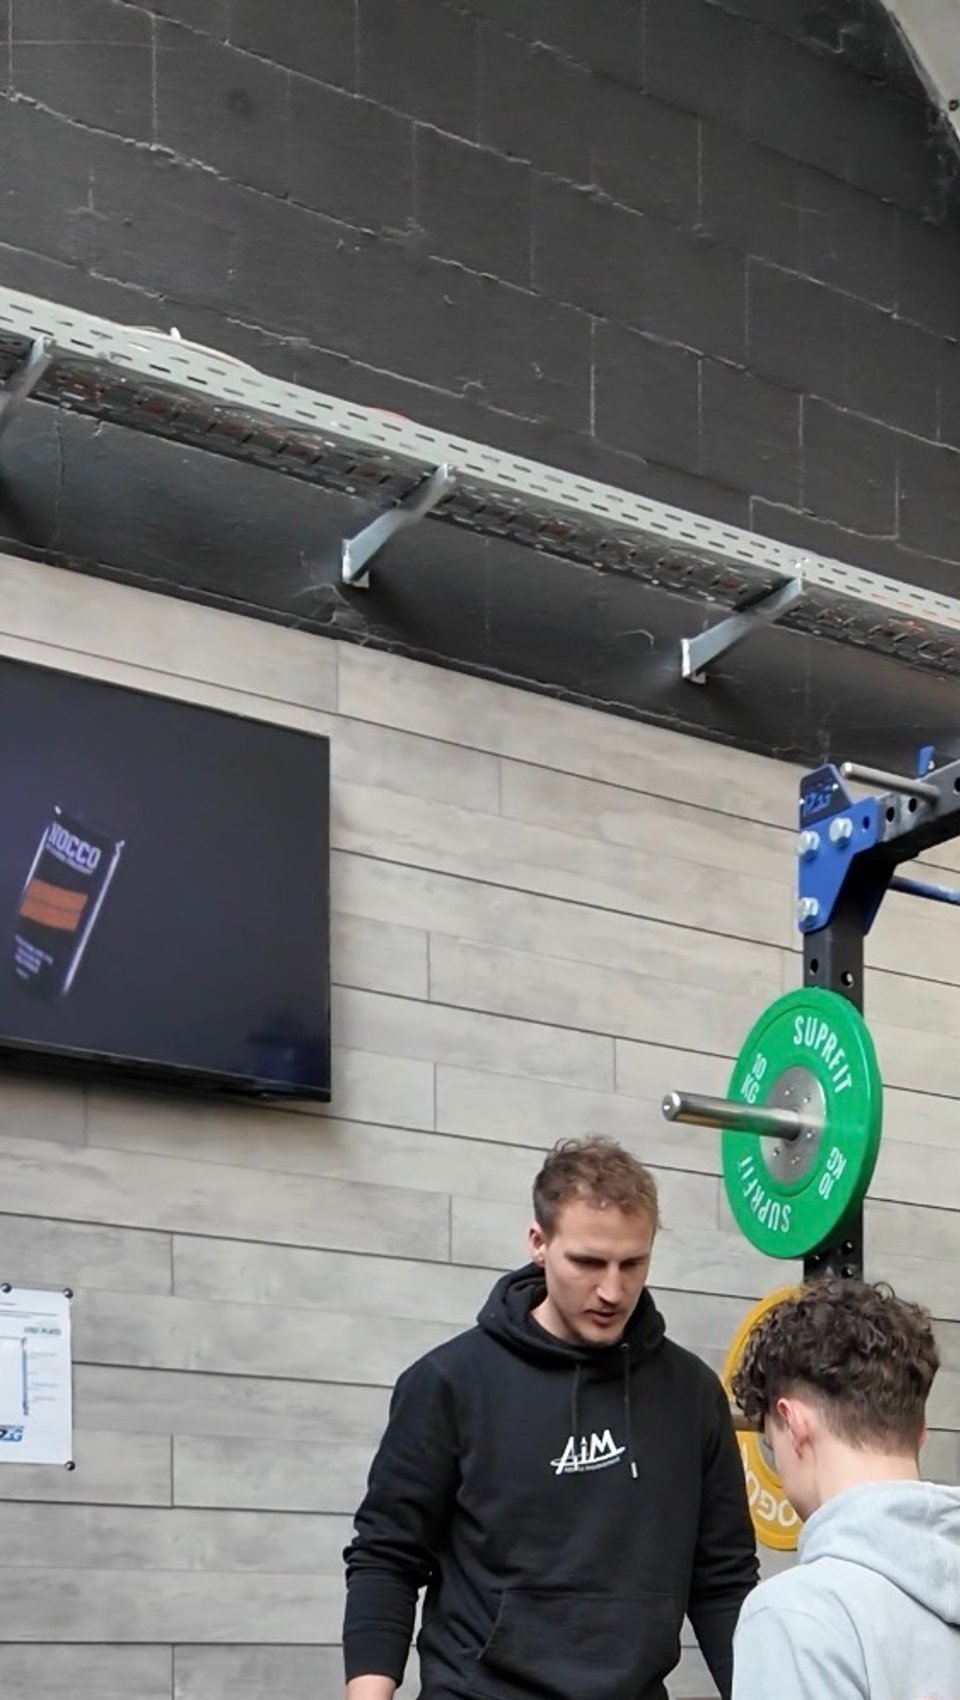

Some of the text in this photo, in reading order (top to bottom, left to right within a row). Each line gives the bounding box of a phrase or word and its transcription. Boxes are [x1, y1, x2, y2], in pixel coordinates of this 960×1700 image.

[48, 822, 102, 870] NOCCO
[751, 1052, 768, 1080] 10
[793, 1015, 852, 1093] SUPRFIT
[740, 1073, 760, 1104] KG
[827, 1147, 847, 1180] KG
[739, 1156, 792, 1233] SUPRFIT
[818, 1174, 835, 1200] 10
